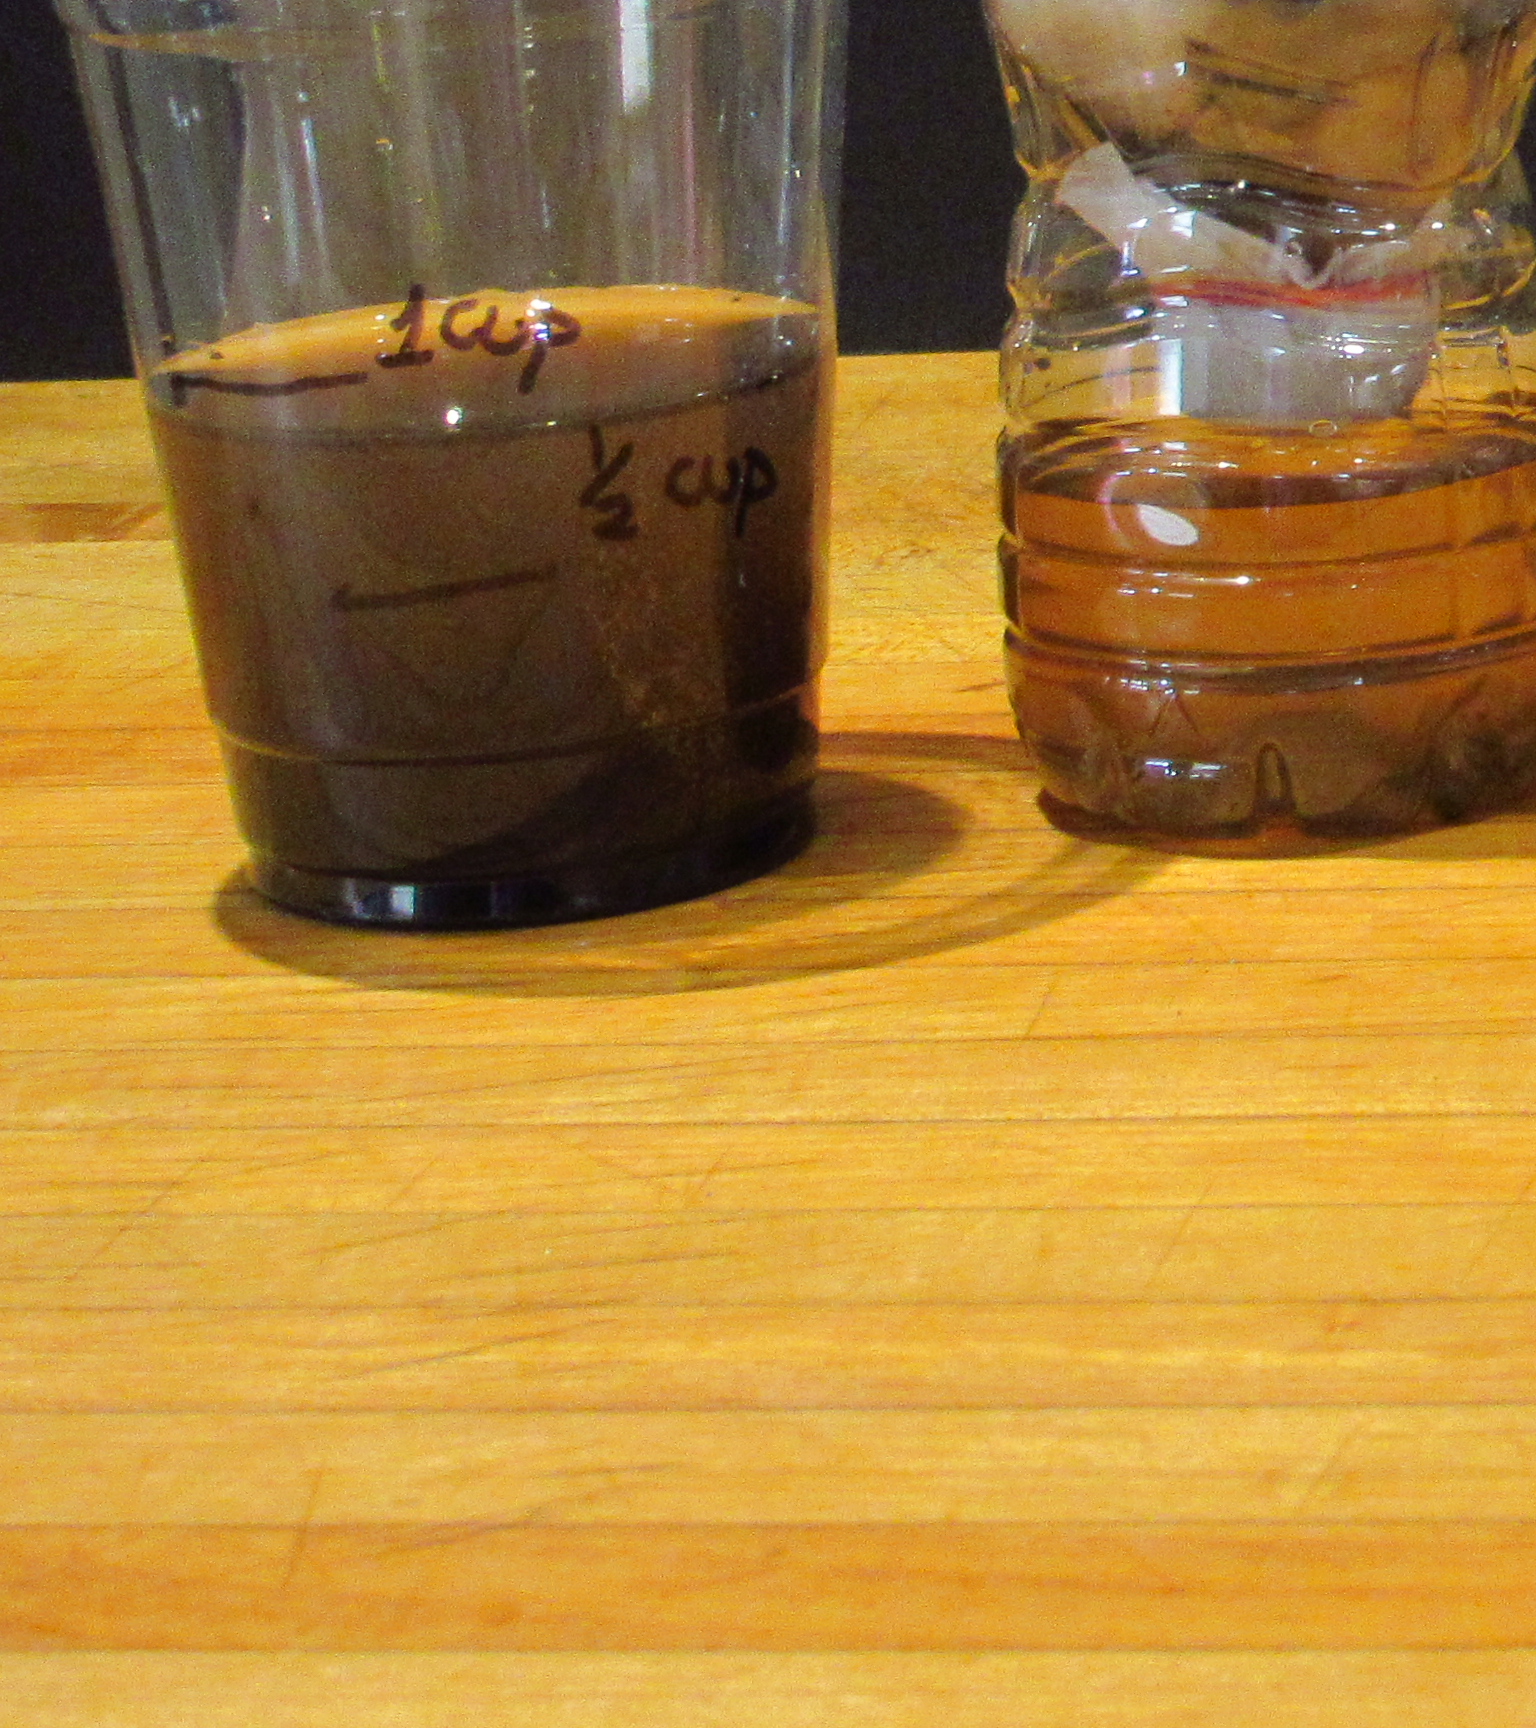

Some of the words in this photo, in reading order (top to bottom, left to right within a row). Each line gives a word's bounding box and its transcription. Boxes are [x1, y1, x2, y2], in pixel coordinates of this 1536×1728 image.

[375, 283, 434, 367] 1
[439, 298, 581, 394] cup
[665, 446, 778, 537] cup
